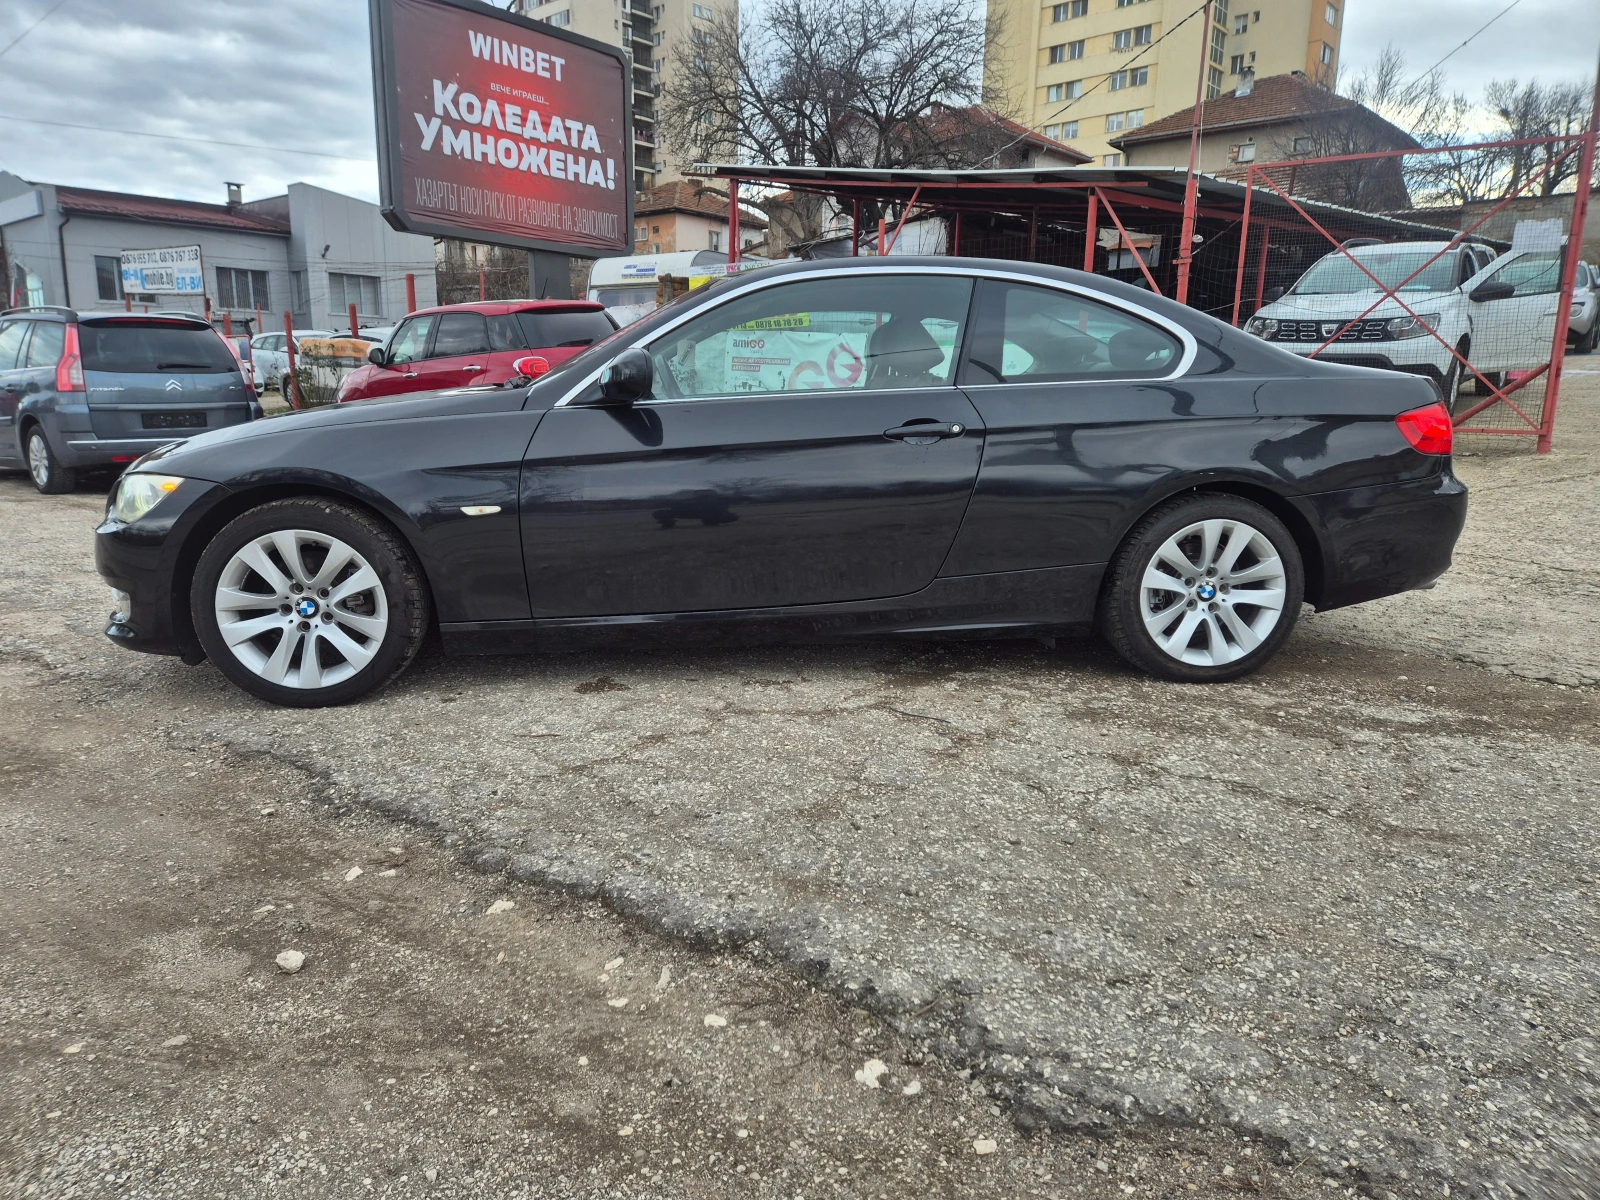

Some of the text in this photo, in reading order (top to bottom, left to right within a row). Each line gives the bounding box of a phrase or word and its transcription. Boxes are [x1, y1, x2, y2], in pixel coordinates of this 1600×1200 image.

[468, 30, 565, 82] WINBET
[432, 79, 602, 154] КОЛЕДАТА
[490, 82, 511, 96] ВЕЧЕ
[414, 112, 616, 191] УМНОЖЕНА!
[415, 177, 619, 239] ХАЗАРТЪТ НОСИ РИСК ОТ РАЗВИВАНЕ НА ЗАВИСИМОСТ
[176, 275, 202, 290] ЕЛ-ВИ
